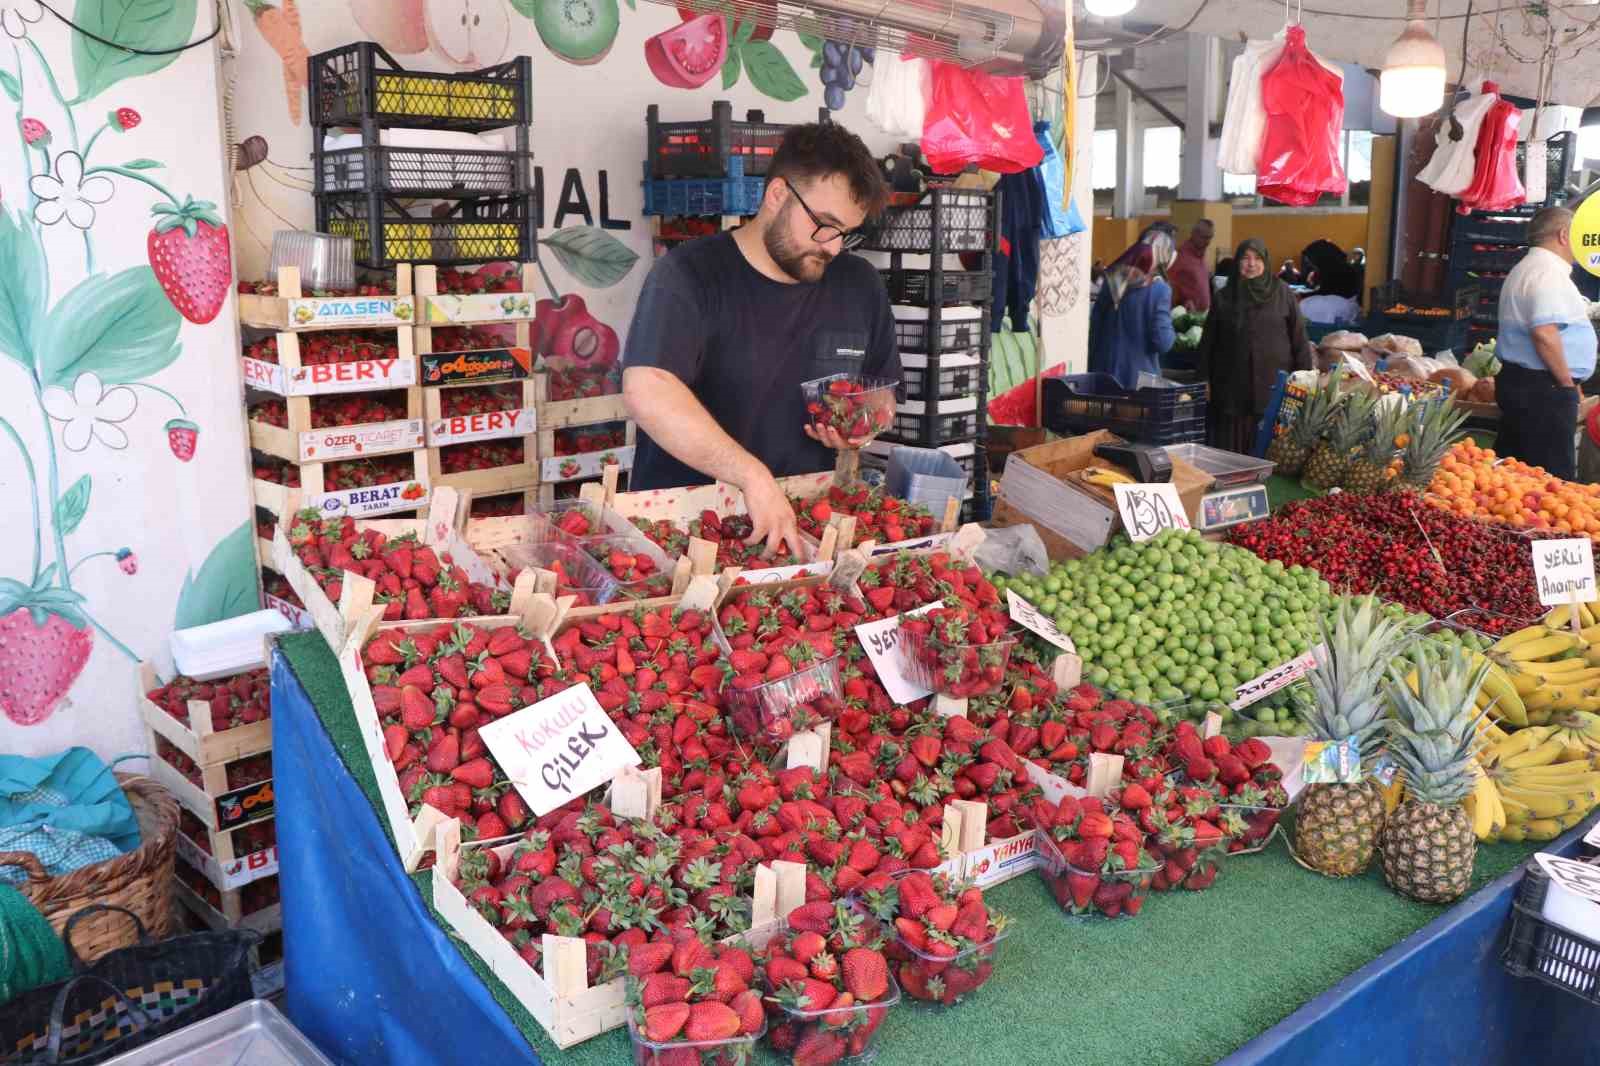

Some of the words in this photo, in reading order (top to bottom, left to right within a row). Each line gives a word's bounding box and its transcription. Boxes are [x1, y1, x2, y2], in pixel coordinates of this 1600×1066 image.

[312, 358, 396, 384] BERY
[449, 410, 521, 435] BERY
[324, 433, 358, 447] ÖZER
[349, 486, 401, 505] BERAT
